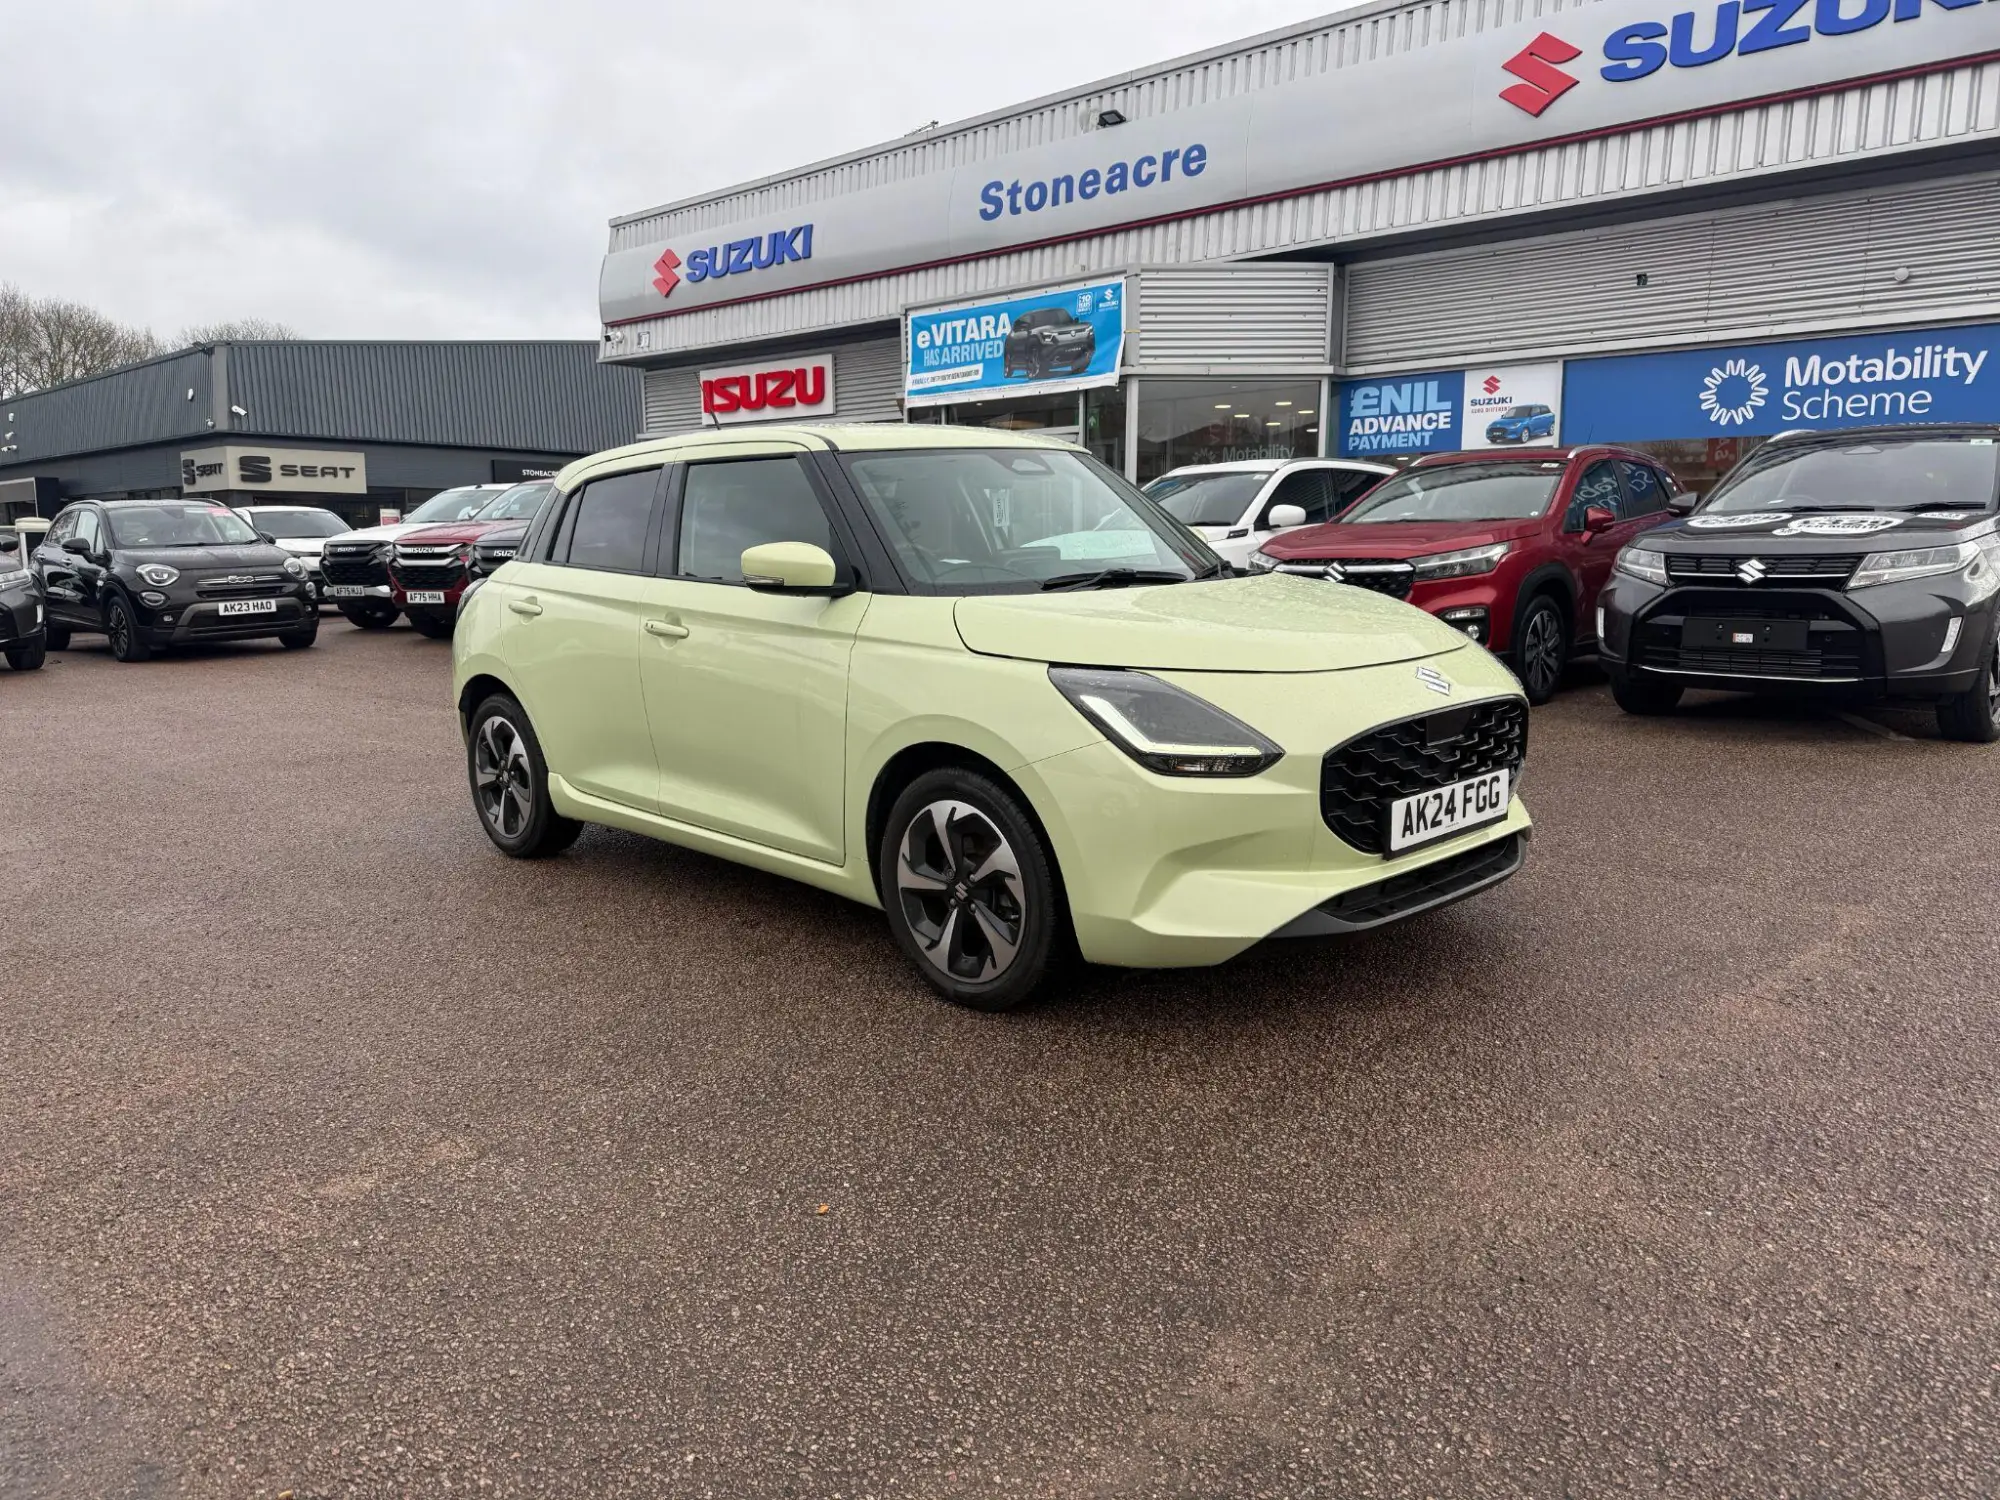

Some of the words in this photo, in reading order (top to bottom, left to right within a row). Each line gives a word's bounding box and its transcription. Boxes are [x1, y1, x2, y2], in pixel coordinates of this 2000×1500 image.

[979, 143, 1207, 222] Stoneacre
[686, 224, 814, 283] SUZUKI
[924, 347, 940, 367] HAS
[941, 339, 1004, 365] ARRIVED
[1785, 345, 1988, 387] Motability
[702, 366, 825, 413] ISUZU
[1350, 380, 1452, 417] £NIL
[1471, 396, 1513, 406] SUZUKI
[1781, 388, 1933, 421] Scheme
[1349, 411, 1452, 436] ADVANCE
[1222, 444, 1295, 462] Motability
[1349, 431, 1434, 451] PAYMENT
[196, 462, 224, 477] SEAT
[279, 464, 356, 479] SEAT
[336, 587, 350, 596] AF75
[409, 592, 427, 602] AF75
[428, 592, 442, 602] HHA
[223, 602, 250, 613] AK23
[252, 601, 272, 612] HAO
[1402, 788, 1456, 838] AK24
[1462, 775, 1501, 819] FGG
